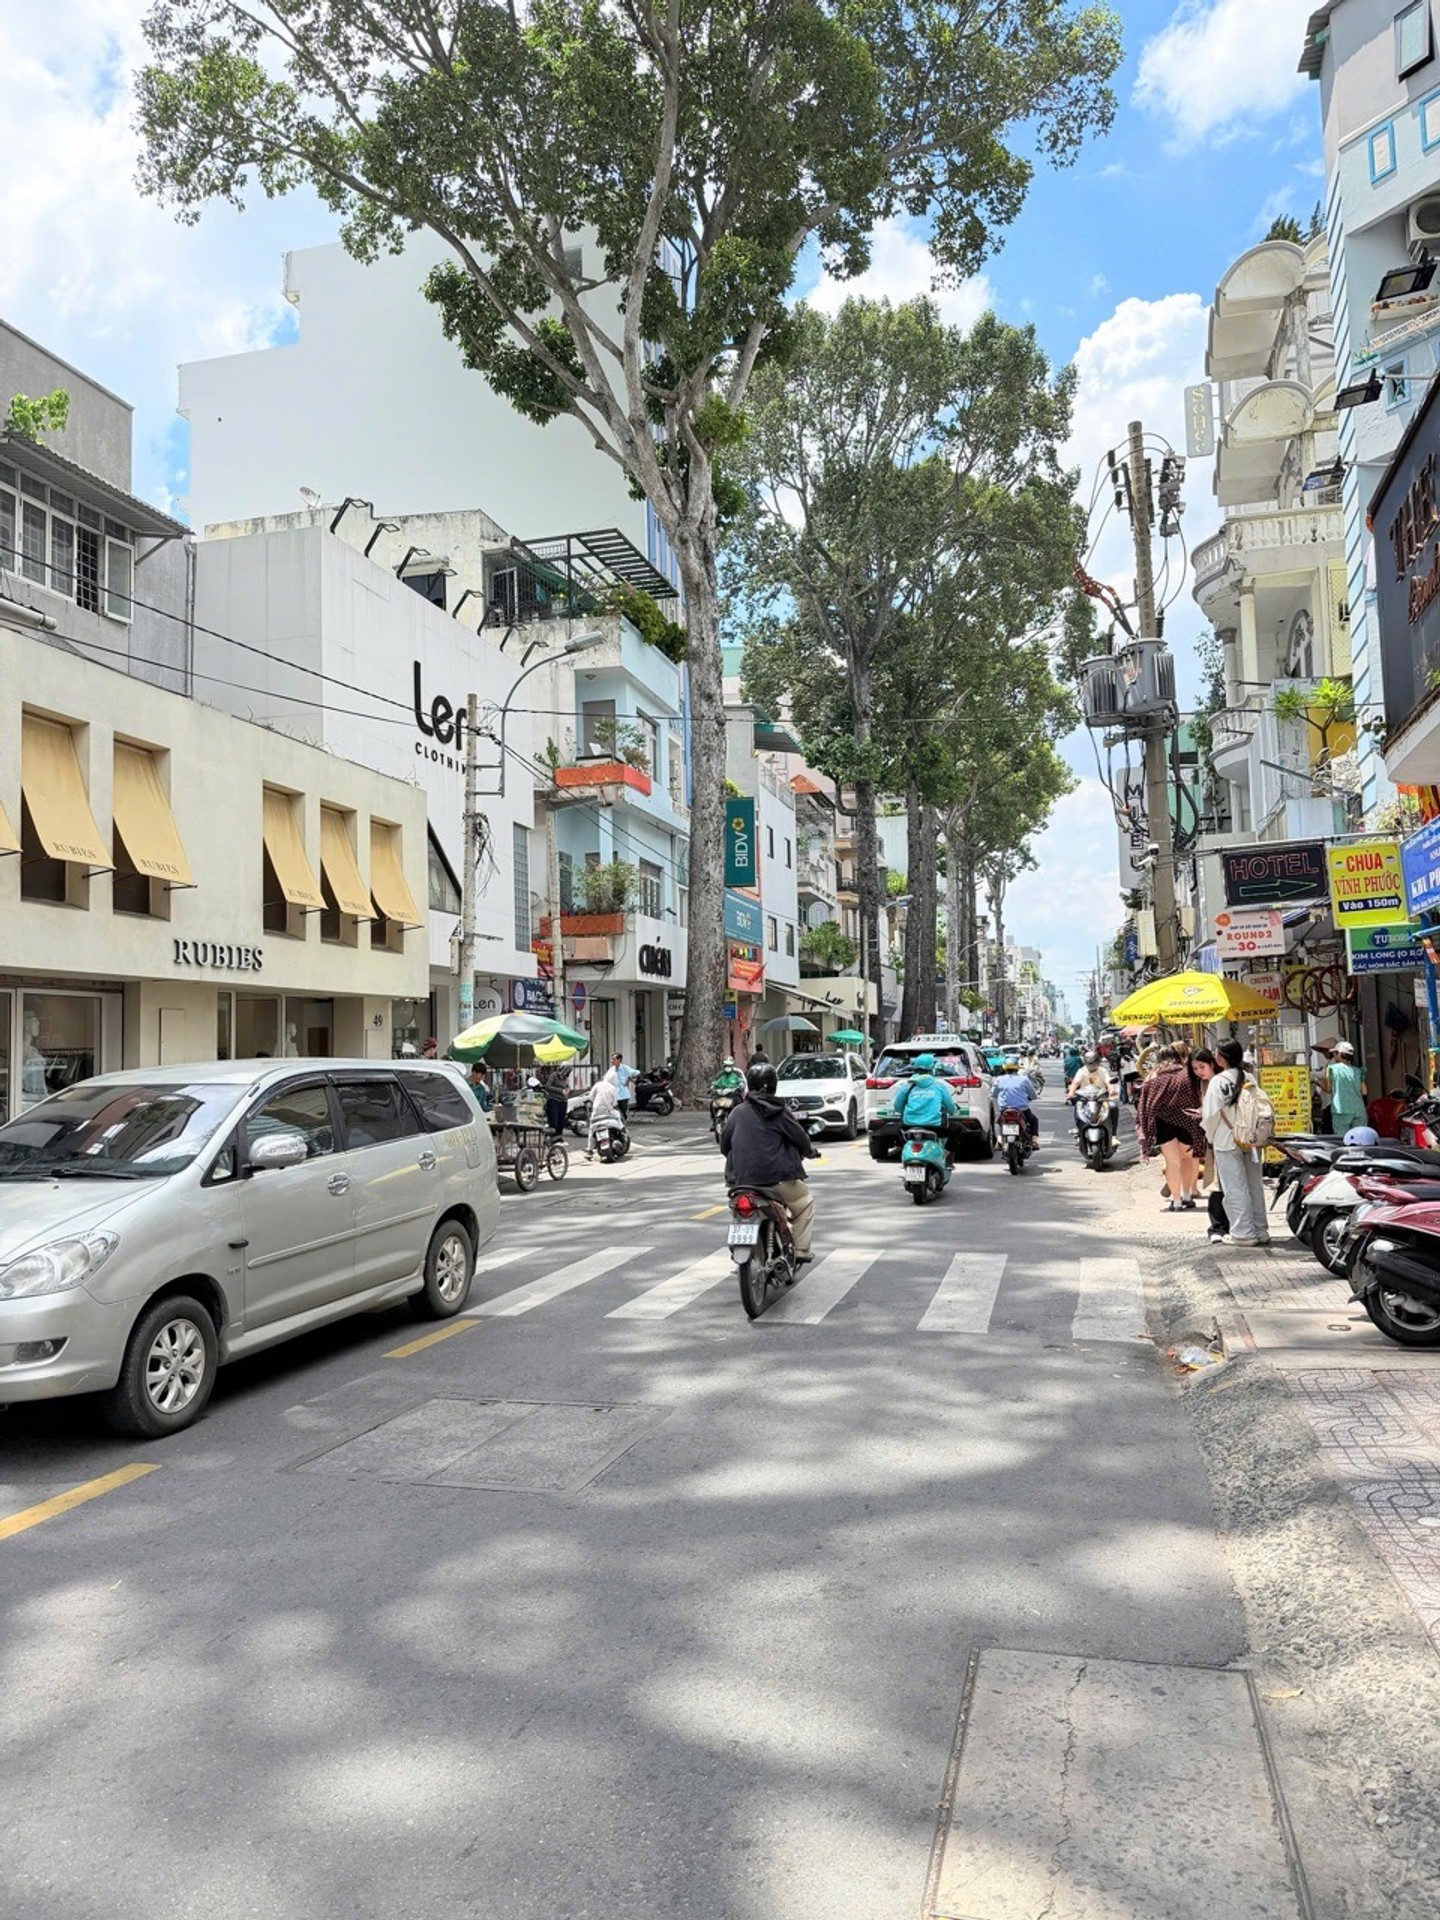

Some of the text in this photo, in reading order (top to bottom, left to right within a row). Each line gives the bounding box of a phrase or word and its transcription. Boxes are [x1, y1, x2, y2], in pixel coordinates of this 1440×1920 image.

[52, 841, 97, 860] RUBIES
[734, 831, 749, 867] BIDV
[140, 859, 180, 875] RUBIES
[1230, 851, 1320, 881] HOTEL
[1345, 849, 1384, 873] CHÙA
[1363, 870, 1401, 893] PHƯỚC
[1342, 900, 1364, 911] Vào
[1367, 897, 1399, 909] 150m
[173, 938, 264, 972] RUBIES
[1238, 941, 1257, 951] 30
[1370, 950, 1396, 960] LONG
[1241, 1008, 1276, 1018] DUNLOP
